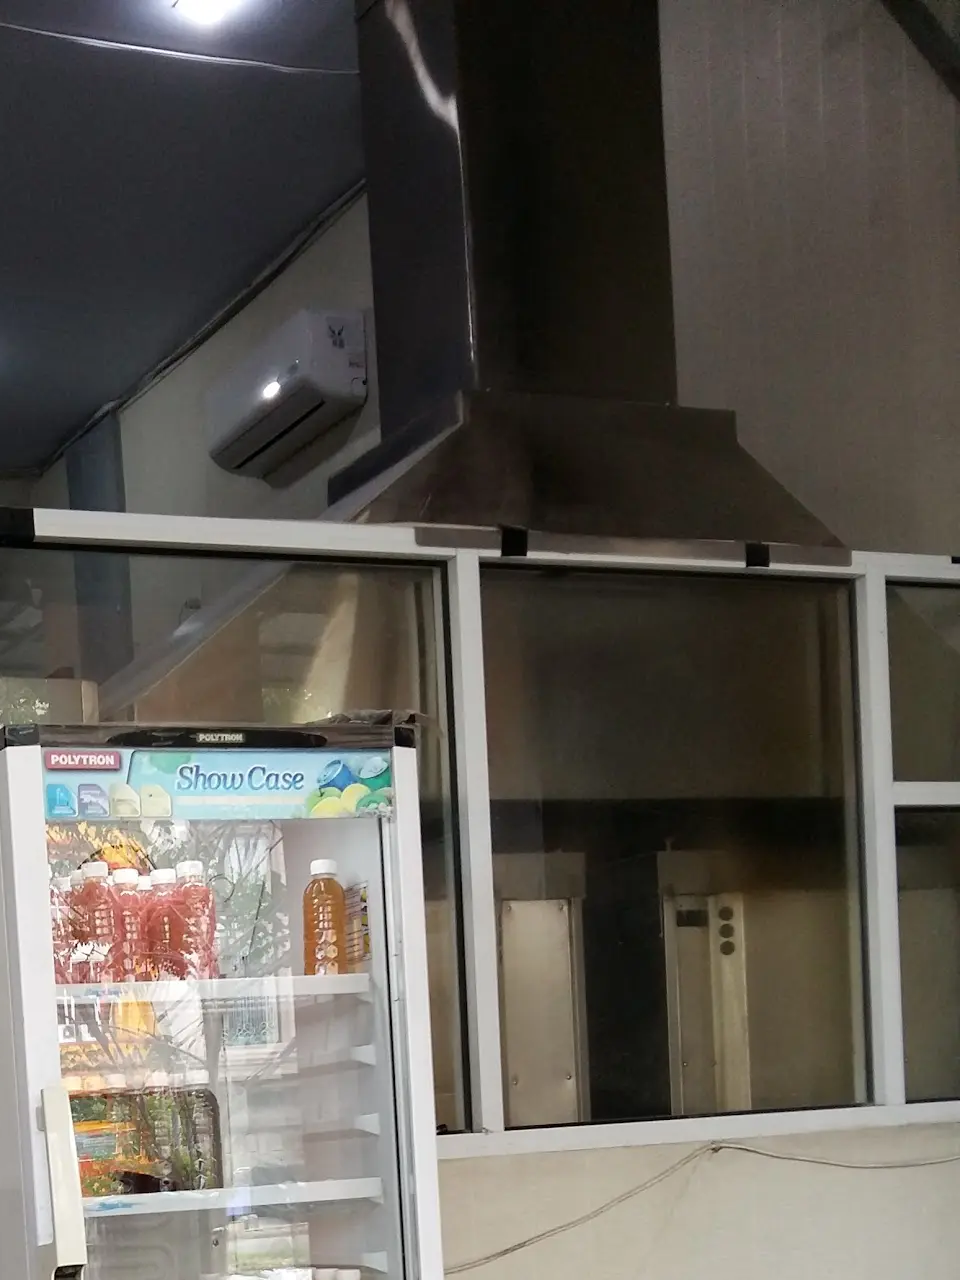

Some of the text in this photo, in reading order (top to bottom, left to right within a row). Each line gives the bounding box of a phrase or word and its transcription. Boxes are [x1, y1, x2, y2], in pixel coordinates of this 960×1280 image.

[198, 733, 243, 742] POLYTRON
[50, 754, 115, 766] POLYTRON
[177, 765, 305, 791] Show Case
